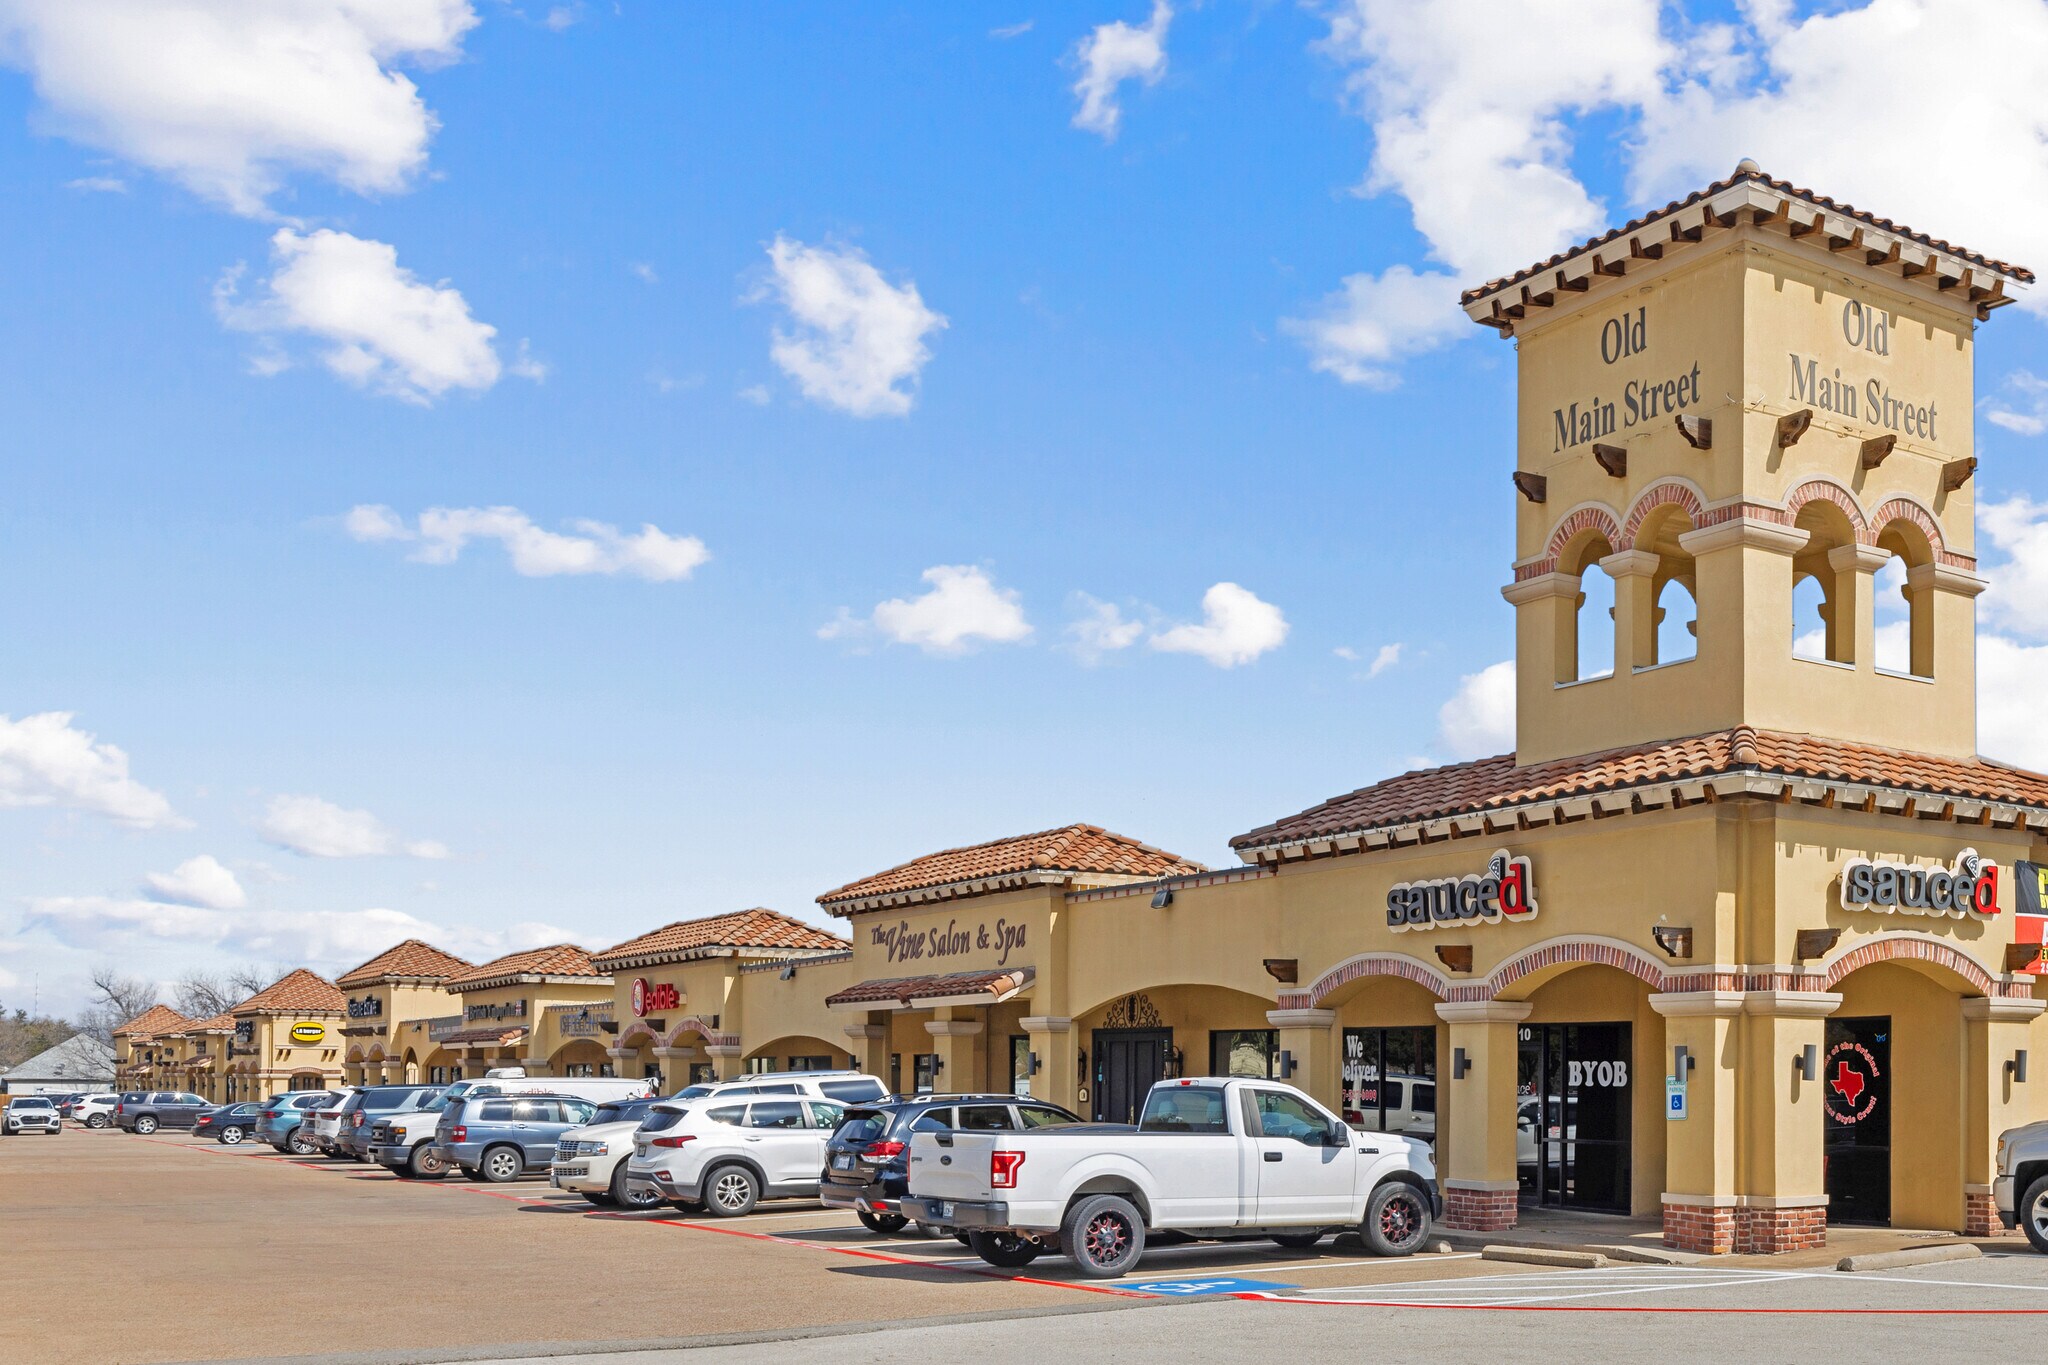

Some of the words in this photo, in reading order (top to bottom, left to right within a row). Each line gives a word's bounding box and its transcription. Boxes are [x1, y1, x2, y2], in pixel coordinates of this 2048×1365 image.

[1601, 306, 1647, 364] Old
[1843, 300, 1889, 357] Old
[1553, 397, 1616, 453] Main
[1624, 360, 1700, 429] Street
[1789, 353, 1857, 418] Main
[1866, 378, 1938, 442] Street
[871, 923, 887, 945] The
[885, 920, 926, 963] Vine
[928, 919, 970, 958] Salon
[976, 924, 990, 949] &
[995, 918, 1026, 966] Spa
[645, 983, 677, 1010] edible
[1346, 1035, 1363, 1058] We
[1568, 1061, 1628, 1087] BYOB
